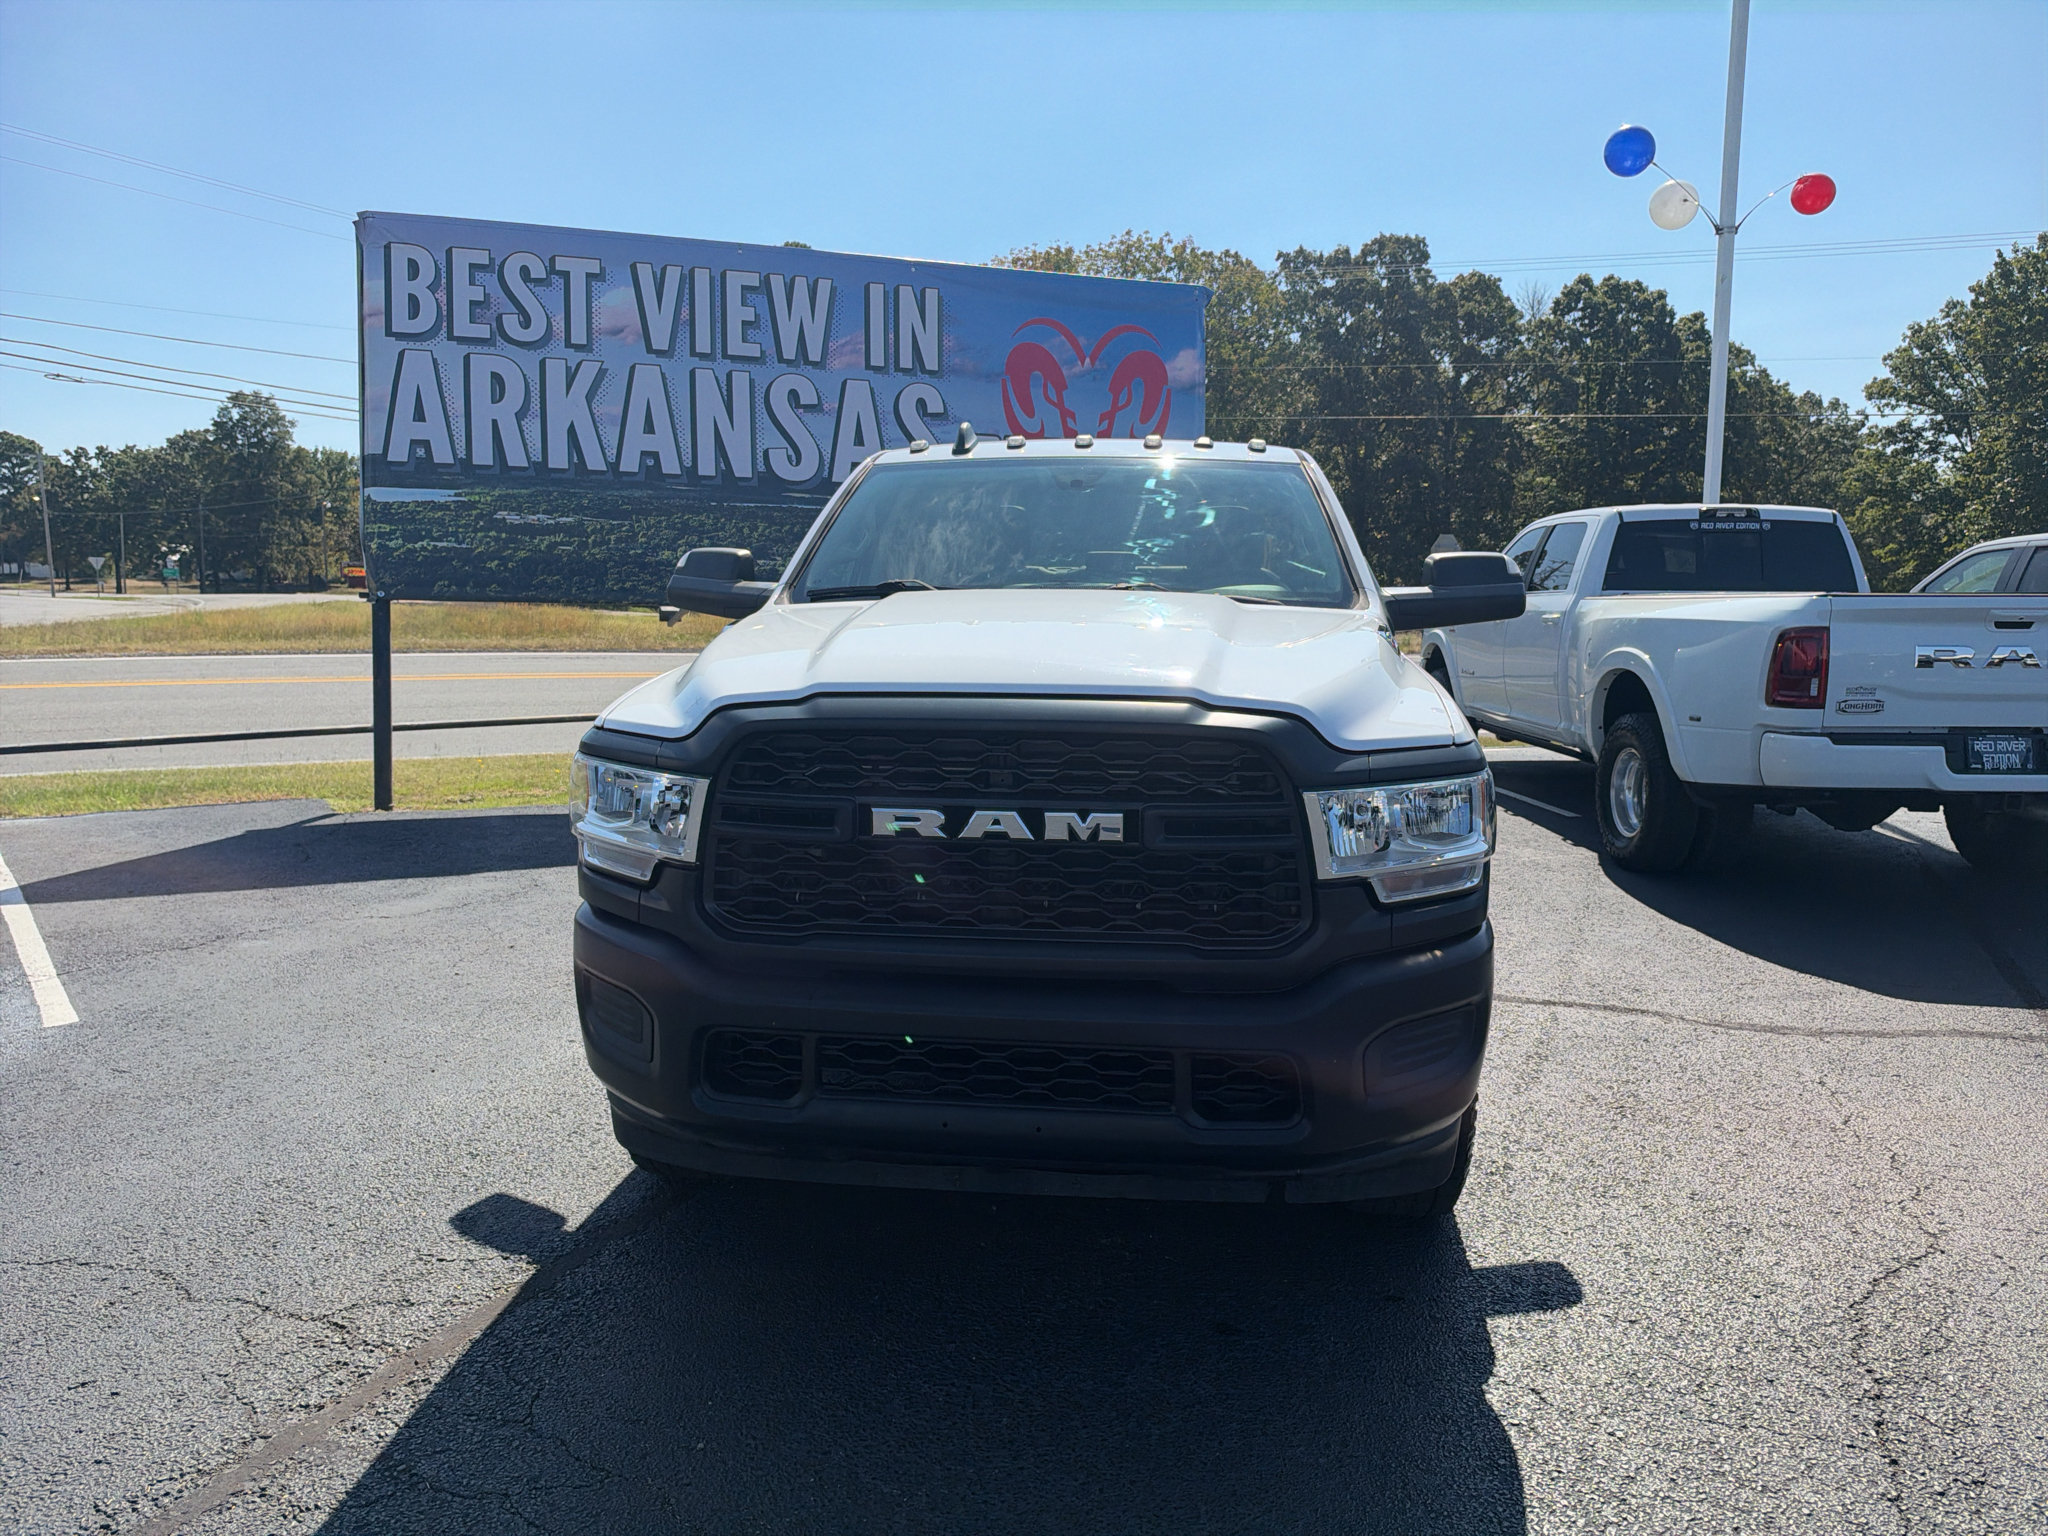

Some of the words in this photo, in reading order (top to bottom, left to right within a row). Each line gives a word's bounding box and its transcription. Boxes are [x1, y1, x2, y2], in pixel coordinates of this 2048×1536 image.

[384, 241, 602, 346] BEST
[630, 262, 833, 365] VIEW
[864, 282, 940, 373] IN
[382, 348, 946, 484] ARKANSAS
[1701, 522, 1714, 530] RED
[1715, 522, 1734, 530] RIVER
[1735, 522, 1760, 530] EDITION
[1915, 645, 2048, 669] RA
[1974, 741, 1994, 752] RED
[1997, 741, 2026, 752] RIVER
[871, 808, 1124, 842] RAM
